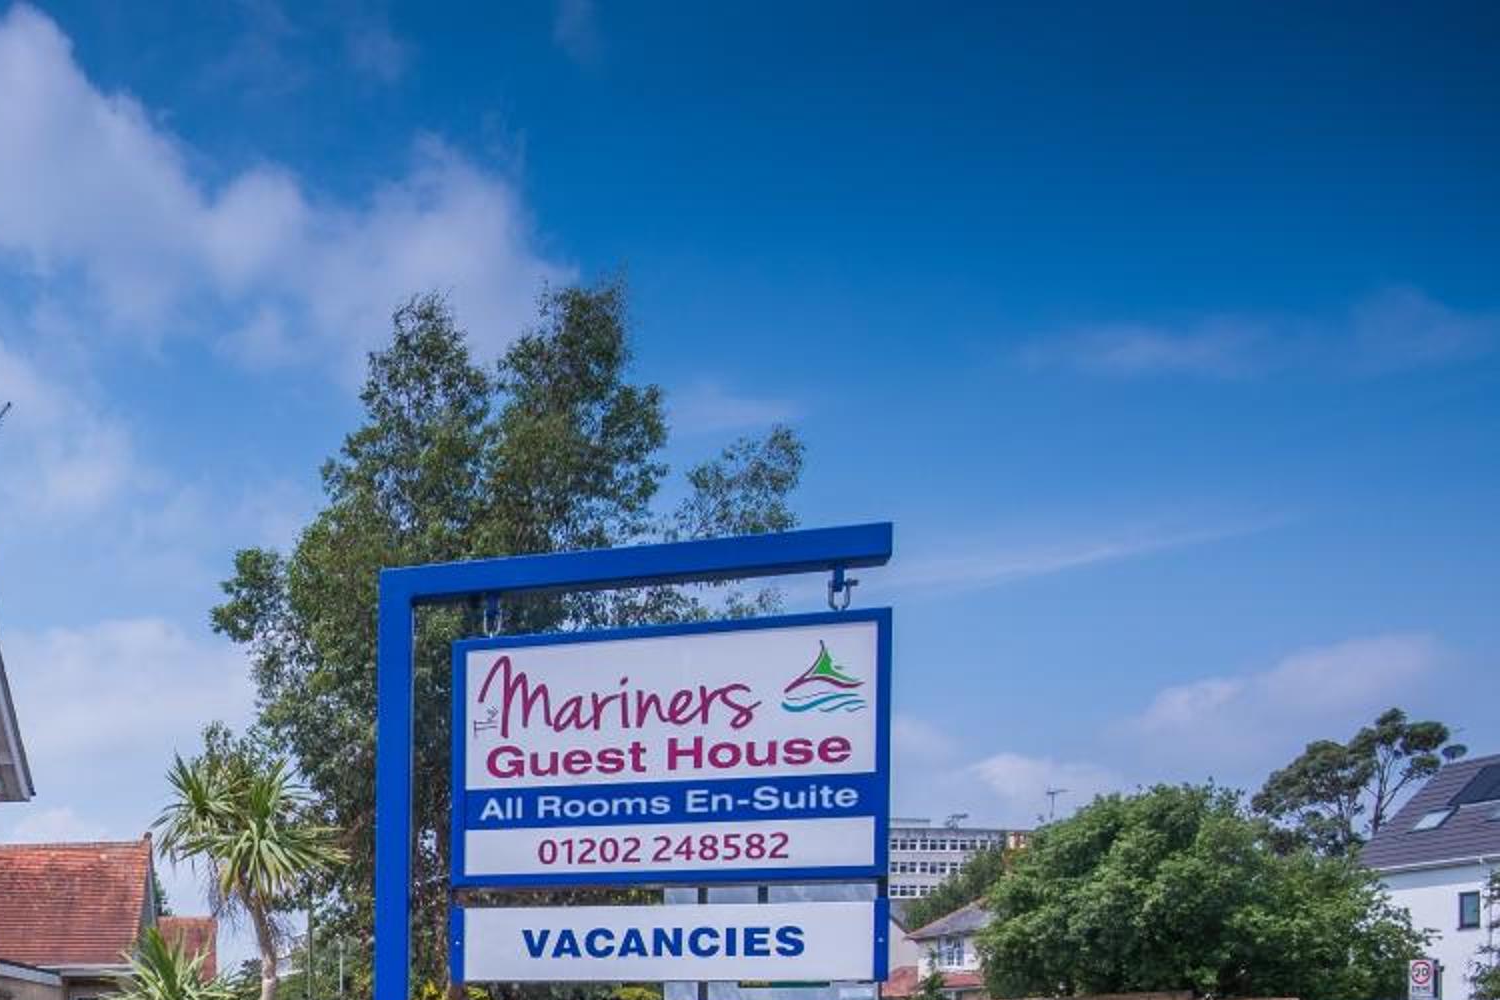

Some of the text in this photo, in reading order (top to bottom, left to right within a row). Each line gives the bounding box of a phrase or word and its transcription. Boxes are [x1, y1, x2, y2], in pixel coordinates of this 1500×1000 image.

[477, 655, 762, 739] Mariners
[486, 735, 852, 779] Guest House
[480, 784, 859, 821] All Rooms En-Suite
[537, 831, 790, 865] 01202 248582
[522, 925, 806, 957] VACANCIES
